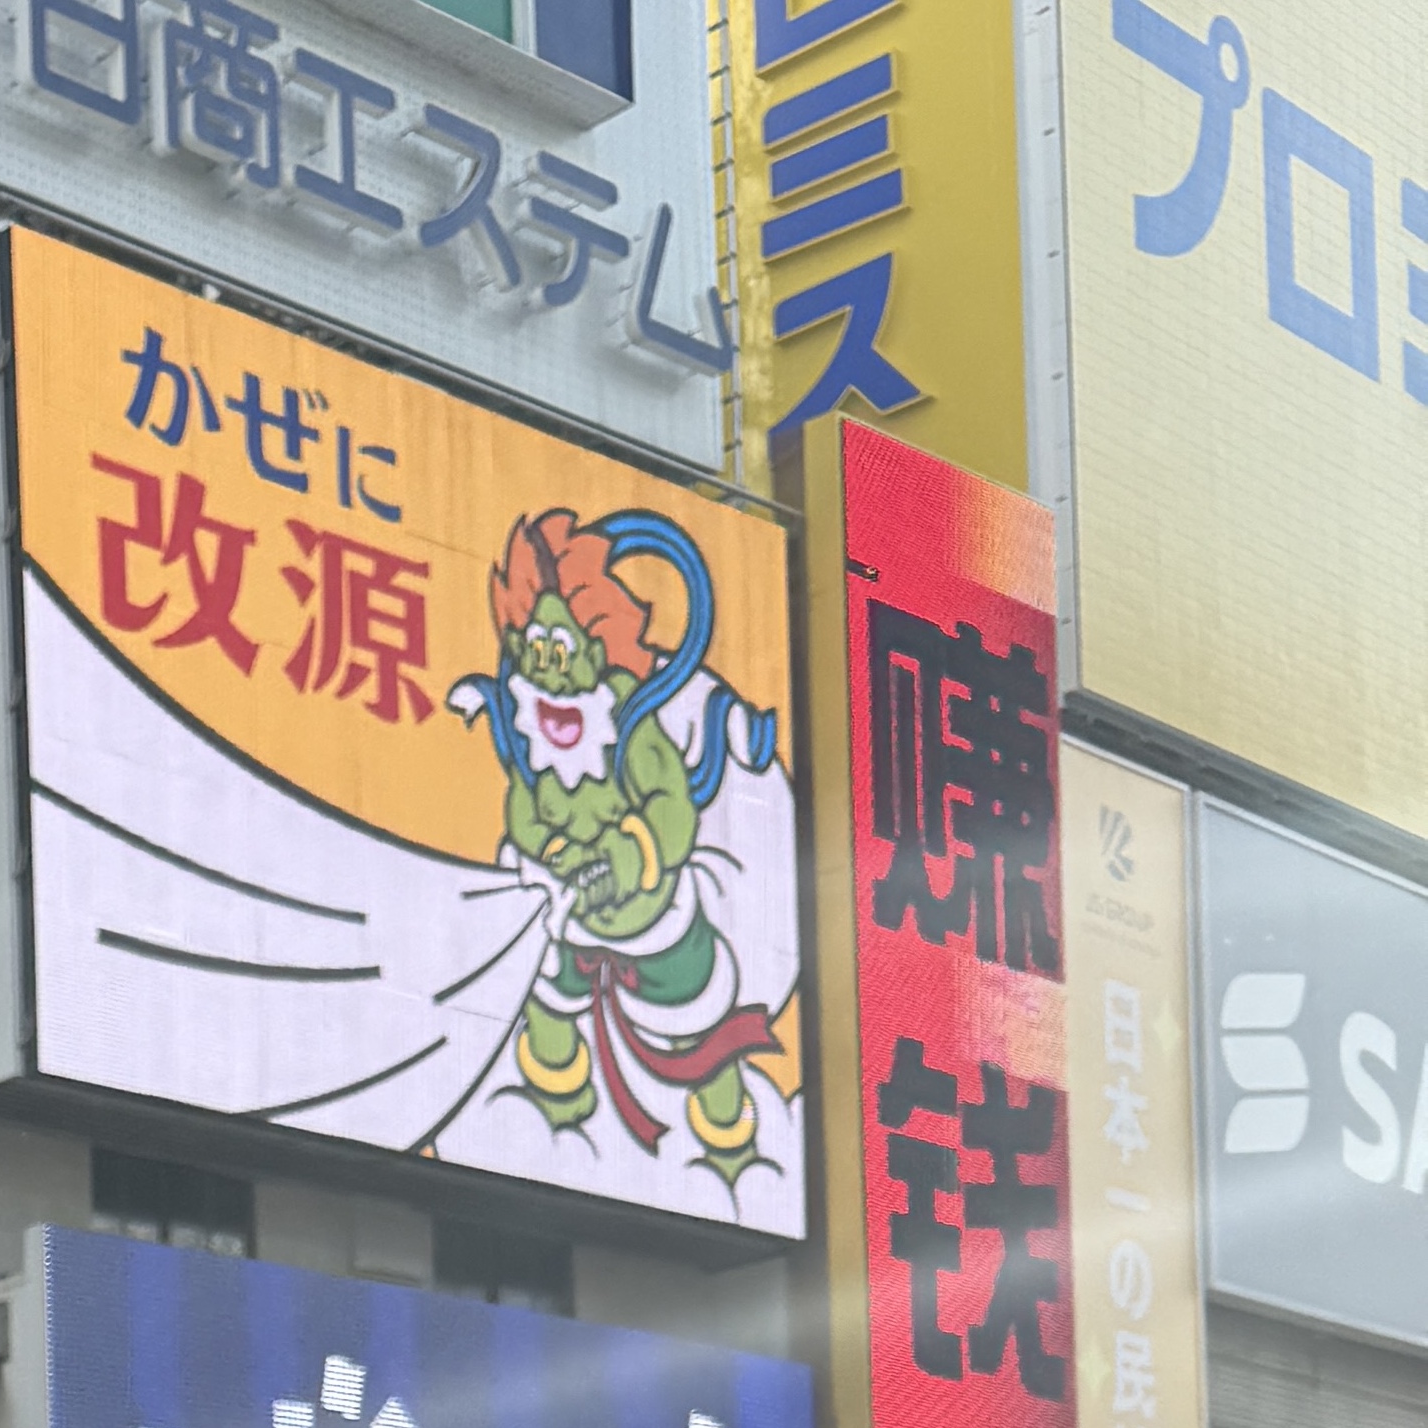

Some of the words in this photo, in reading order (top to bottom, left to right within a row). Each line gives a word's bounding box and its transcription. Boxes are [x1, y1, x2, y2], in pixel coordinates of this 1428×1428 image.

[1112, 0, 1428, 406] プロ
[121, 326, 402, 523] かぜに
[90, 451, 435, 725] 改源
